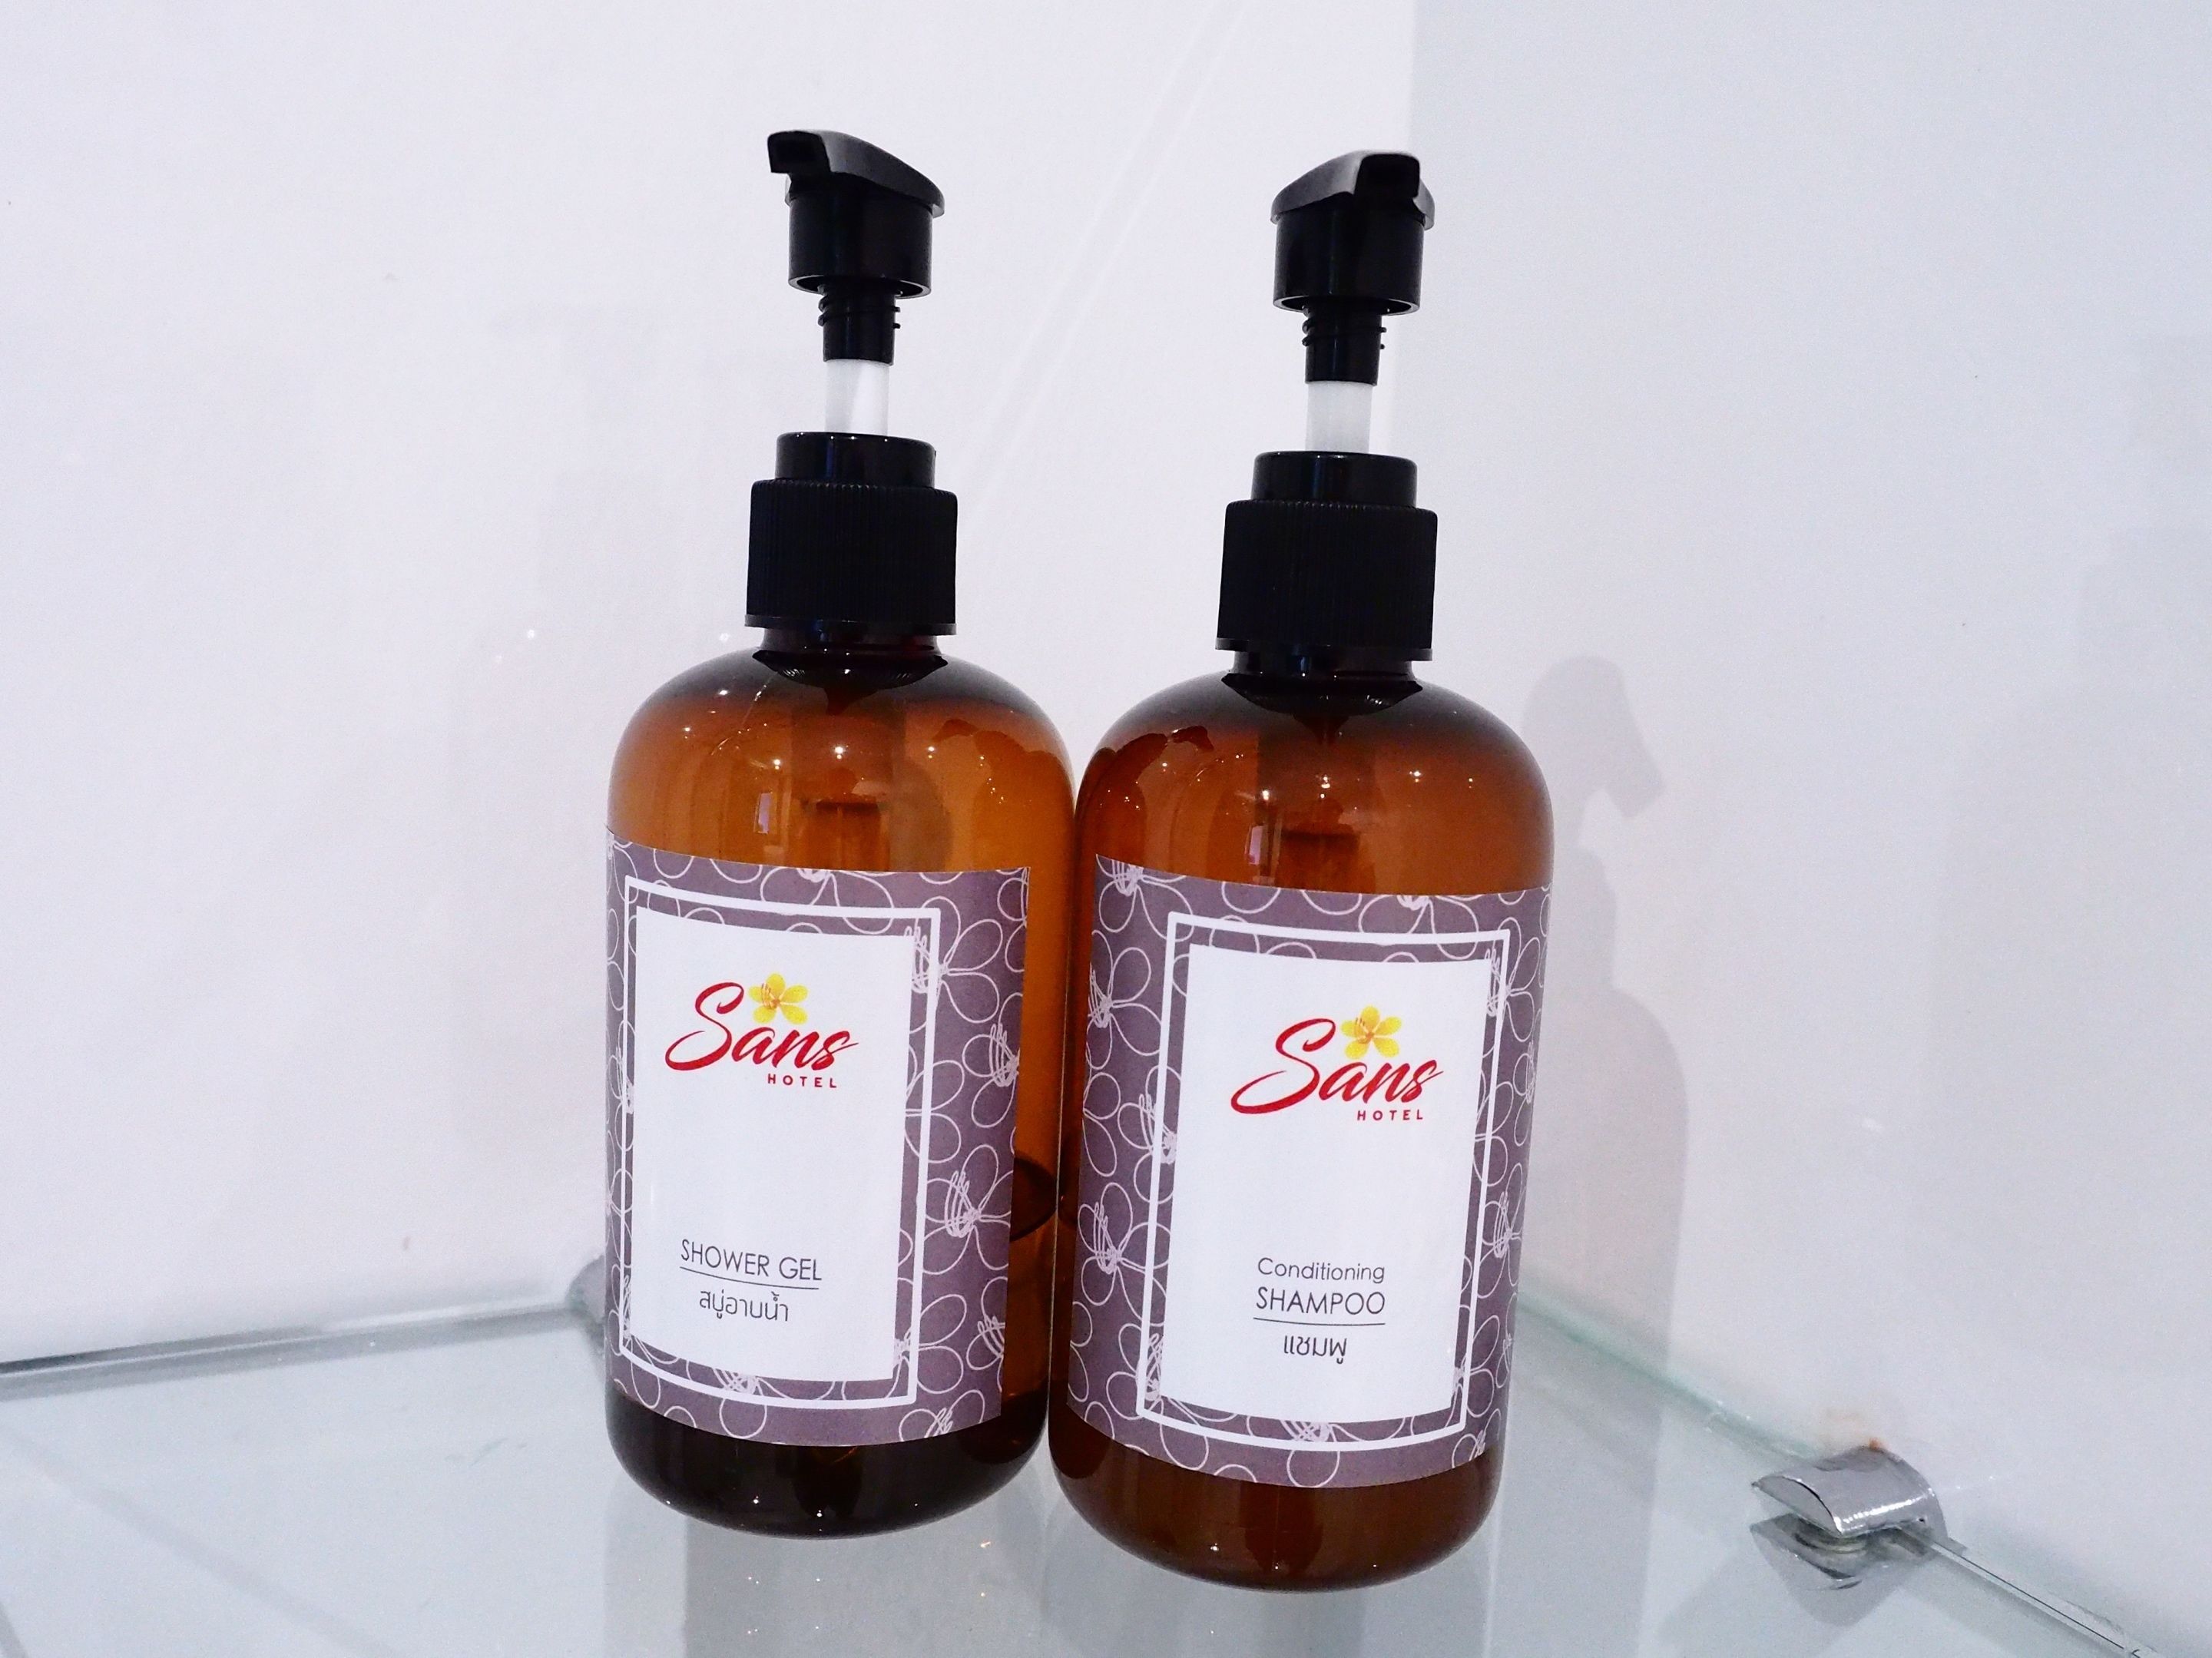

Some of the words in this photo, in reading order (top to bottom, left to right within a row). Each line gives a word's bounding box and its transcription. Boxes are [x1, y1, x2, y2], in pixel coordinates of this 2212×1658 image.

[664, 981, 859, 1071] Sans
[767, 1073, 838, 1089] HOTEL
[1230, 1018, 1444, 1114] Sans
[1356, 1109, 1424, 1122] HOTEL
[680, 1238, 770, 1277] SHOWER
[778, 1256, 823, 1281] GEL
[1257, 1256, 1386, 1284] Conditioning
[699, 1289, 790, 1322] สบู่อาบน้ำ
[1256, 1286, 1386, 1315] SHAMPOO
[1283, 1335, 1348, 1365] แชมพู
